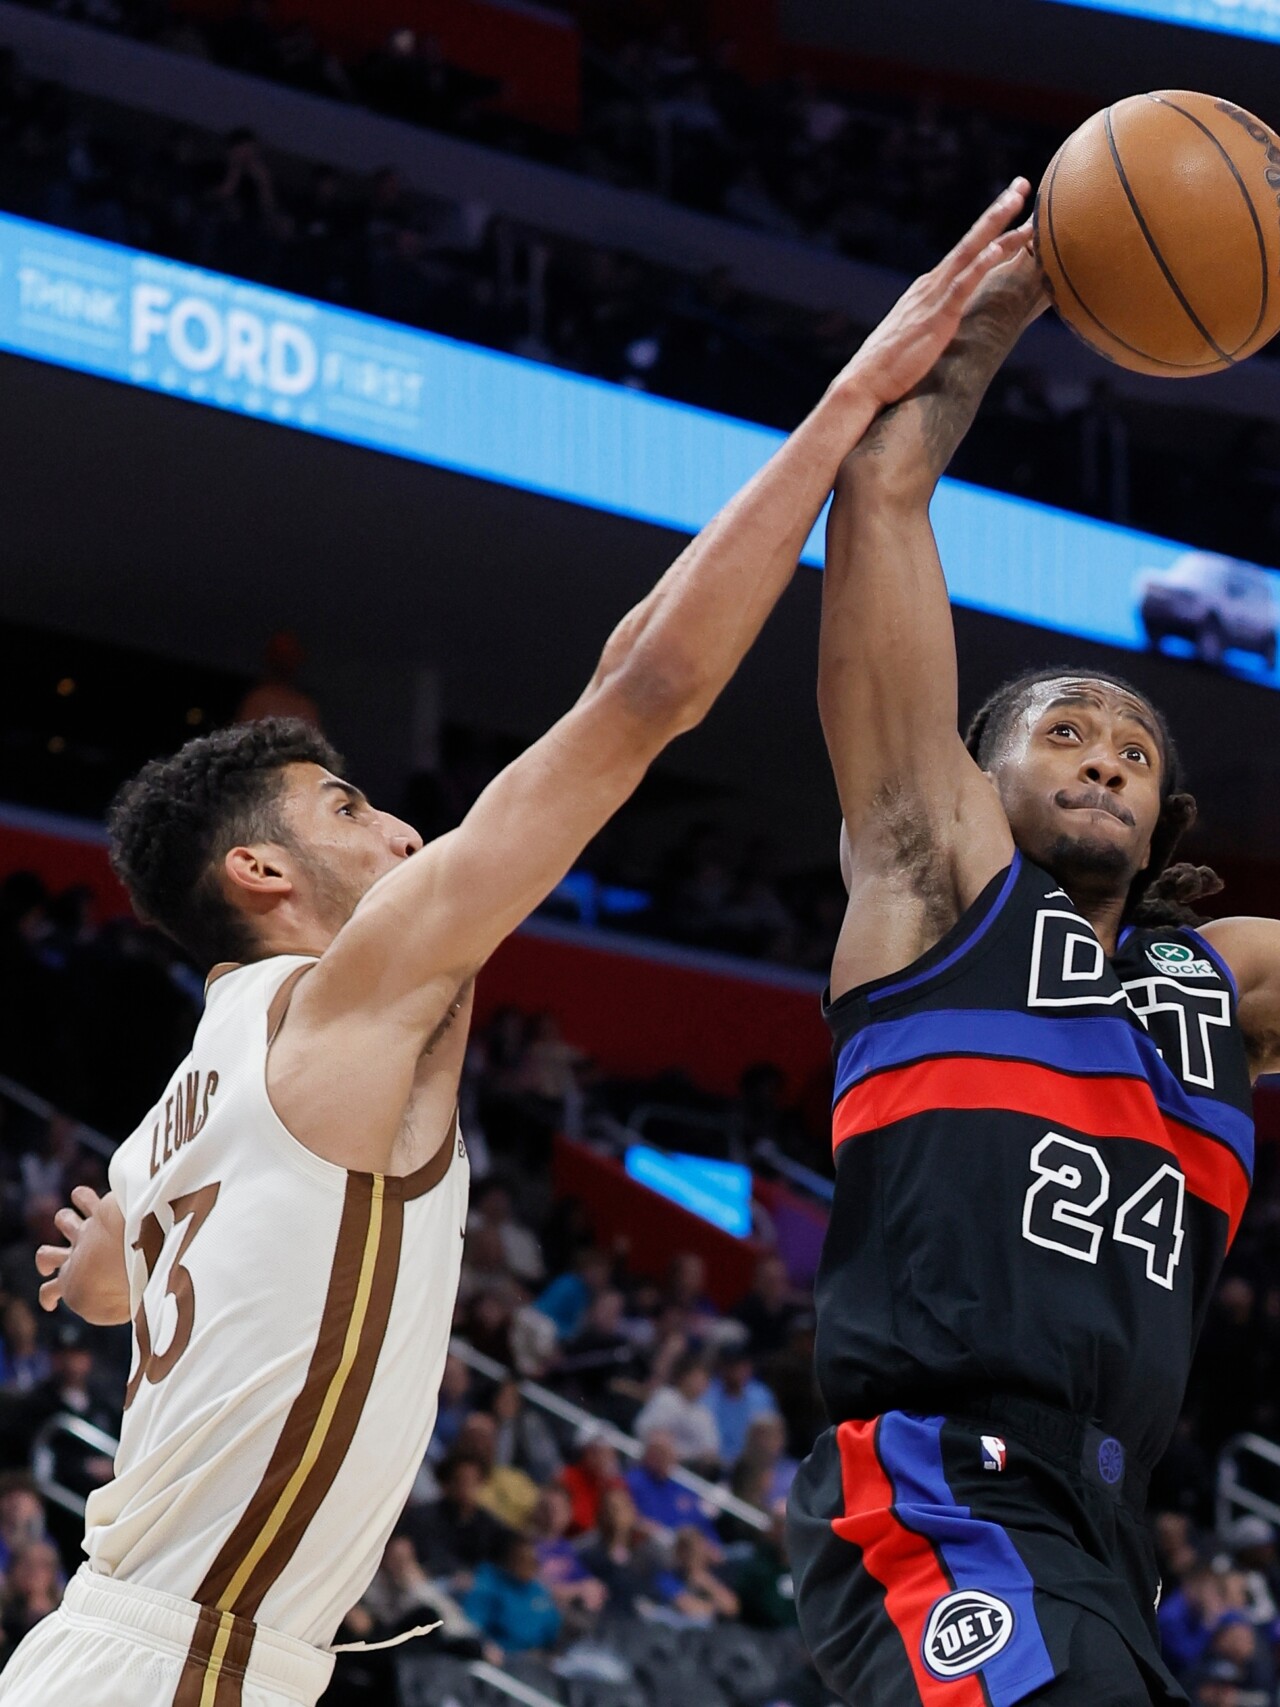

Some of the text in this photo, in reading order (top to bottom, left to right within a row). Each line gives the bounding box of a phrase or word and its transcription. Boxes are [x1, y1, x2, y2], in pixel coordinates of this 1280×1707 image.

[131, 284, 317, 396] FORD
[150, 1070, 219, 1179] LEONS
[1022, 1131, 1186, 1291] 24
[936, 1609, 995, 1658] DET
